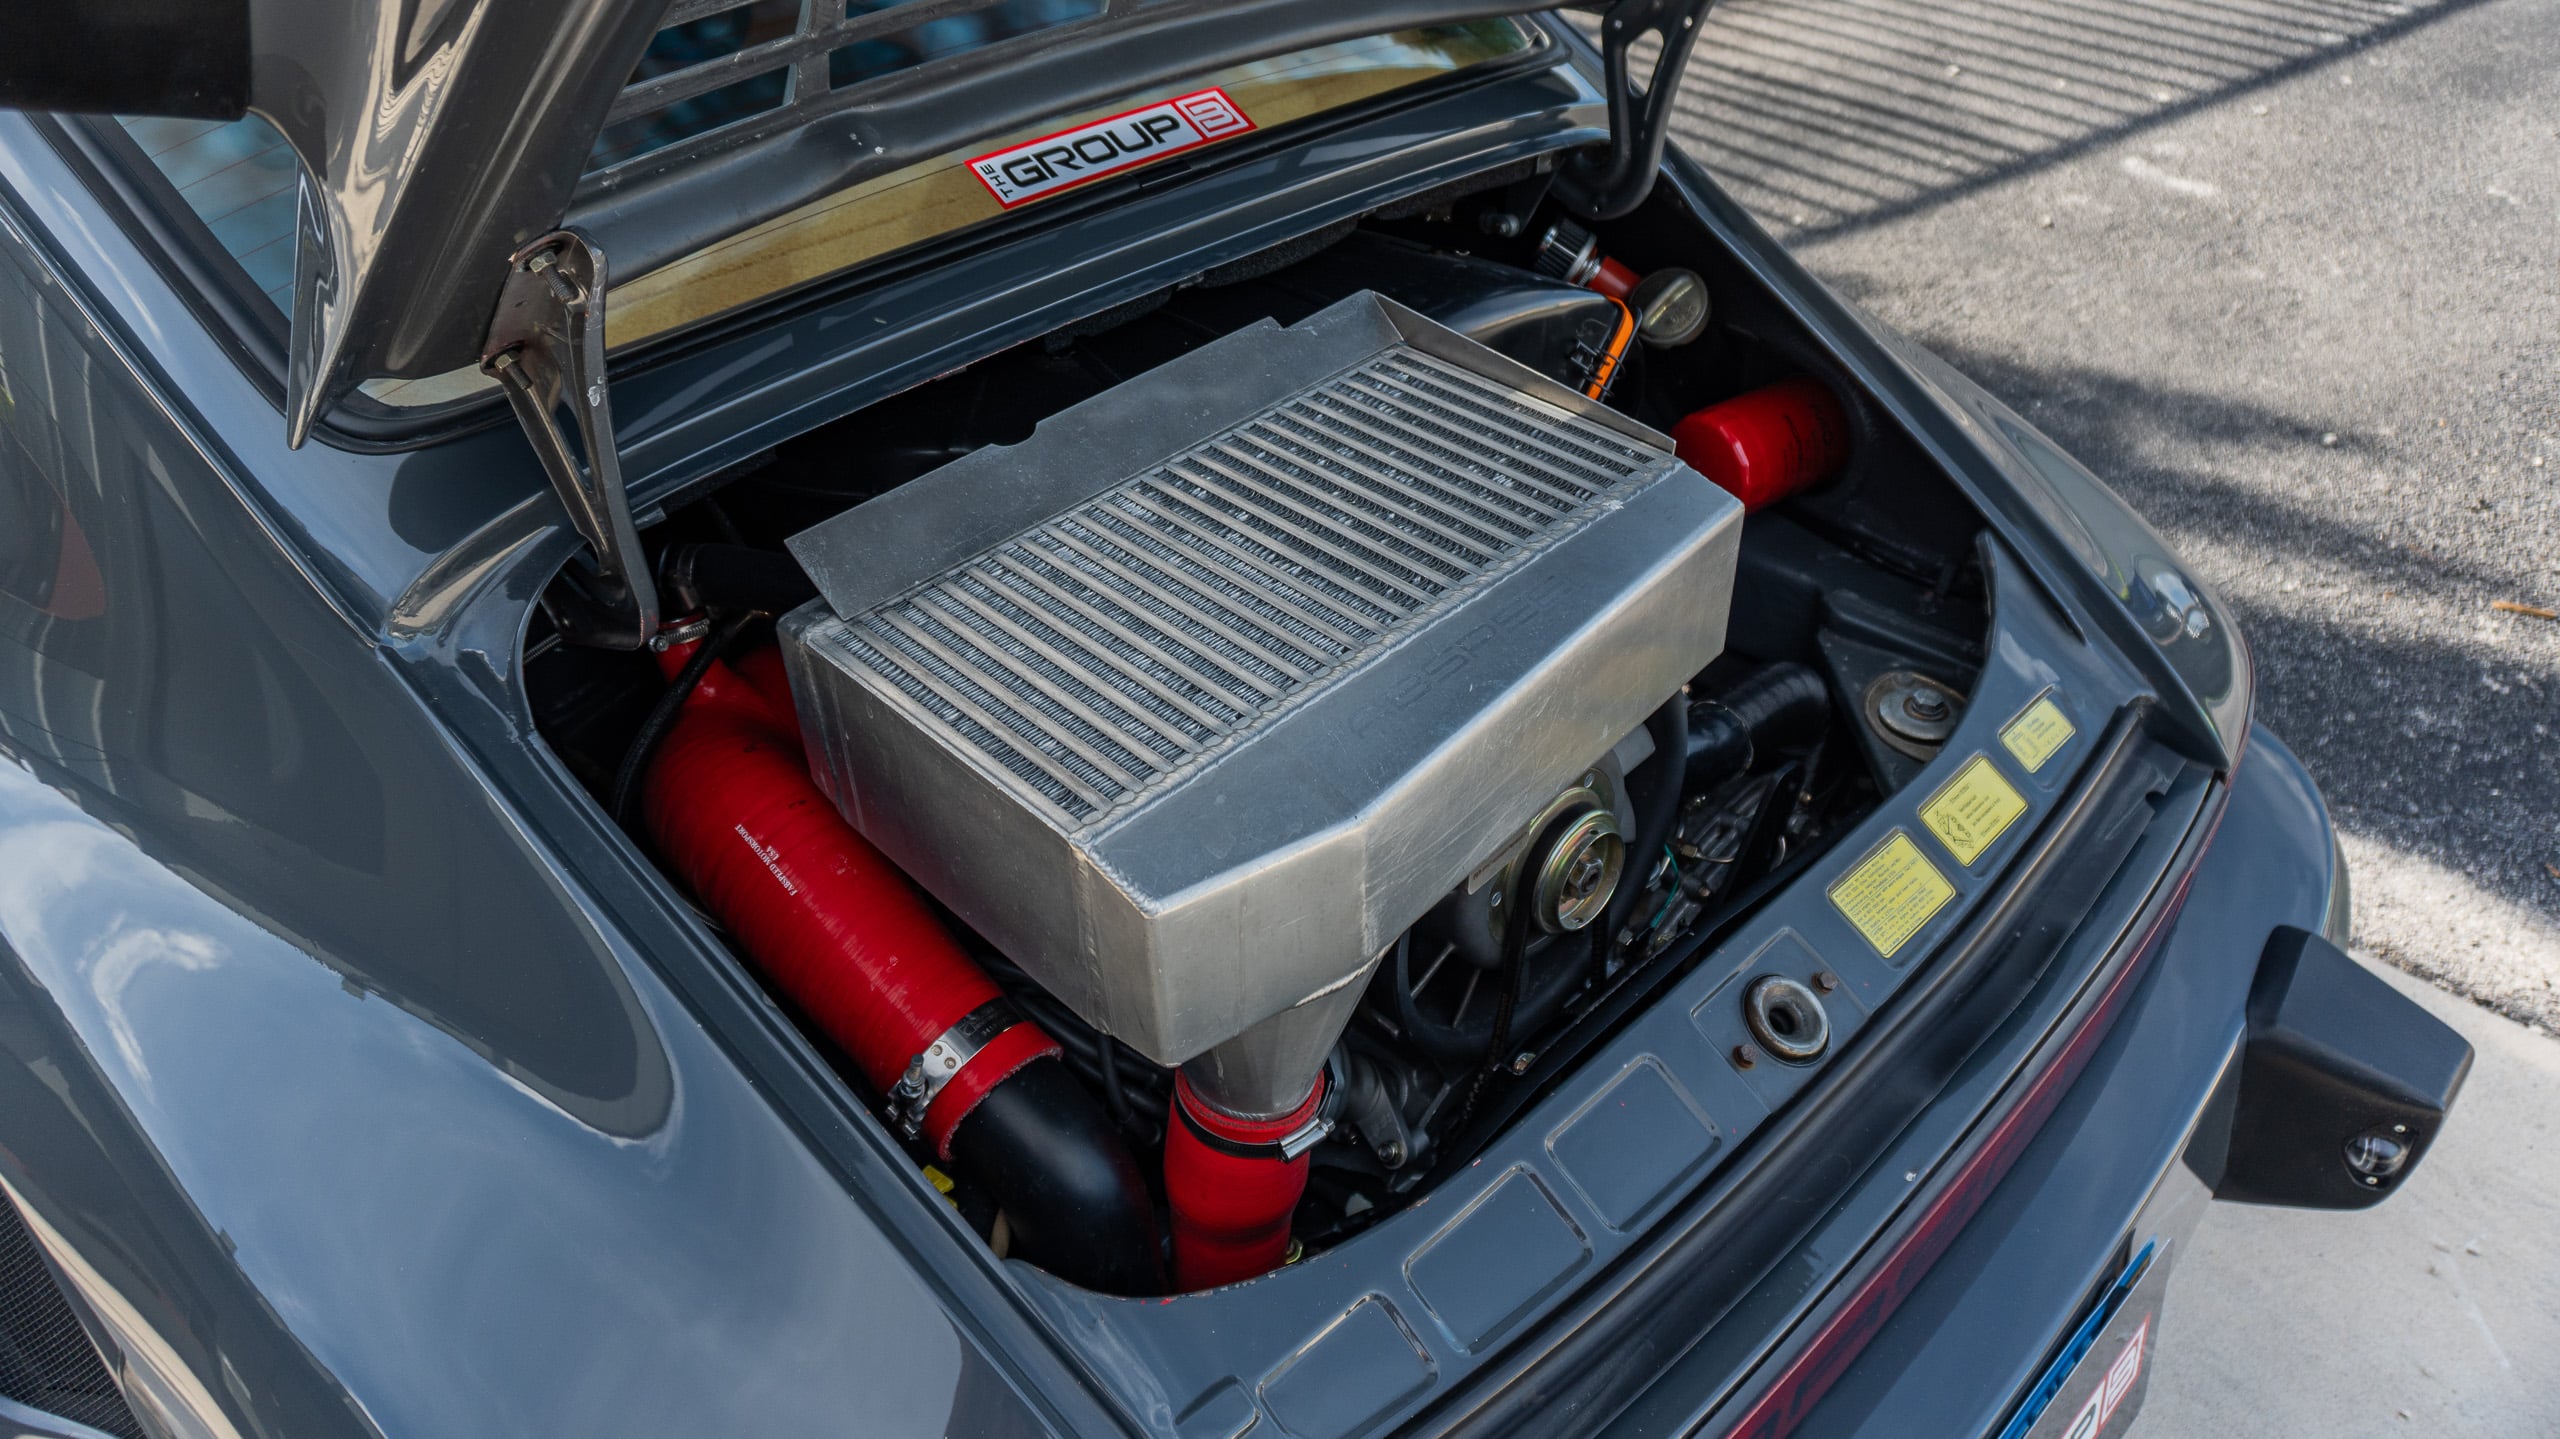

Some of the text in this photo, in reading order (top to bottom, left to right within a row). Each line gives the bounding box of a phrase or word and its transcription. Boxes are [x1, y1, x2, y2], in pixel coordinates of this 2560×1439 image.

[979, 163, 1013, 199] THE
[1000, 114, 1181, 188] GROUP
[734, 823, 798, 896] FABSPEED MOTORSPORT
[766, 845, 780, 861] USA
